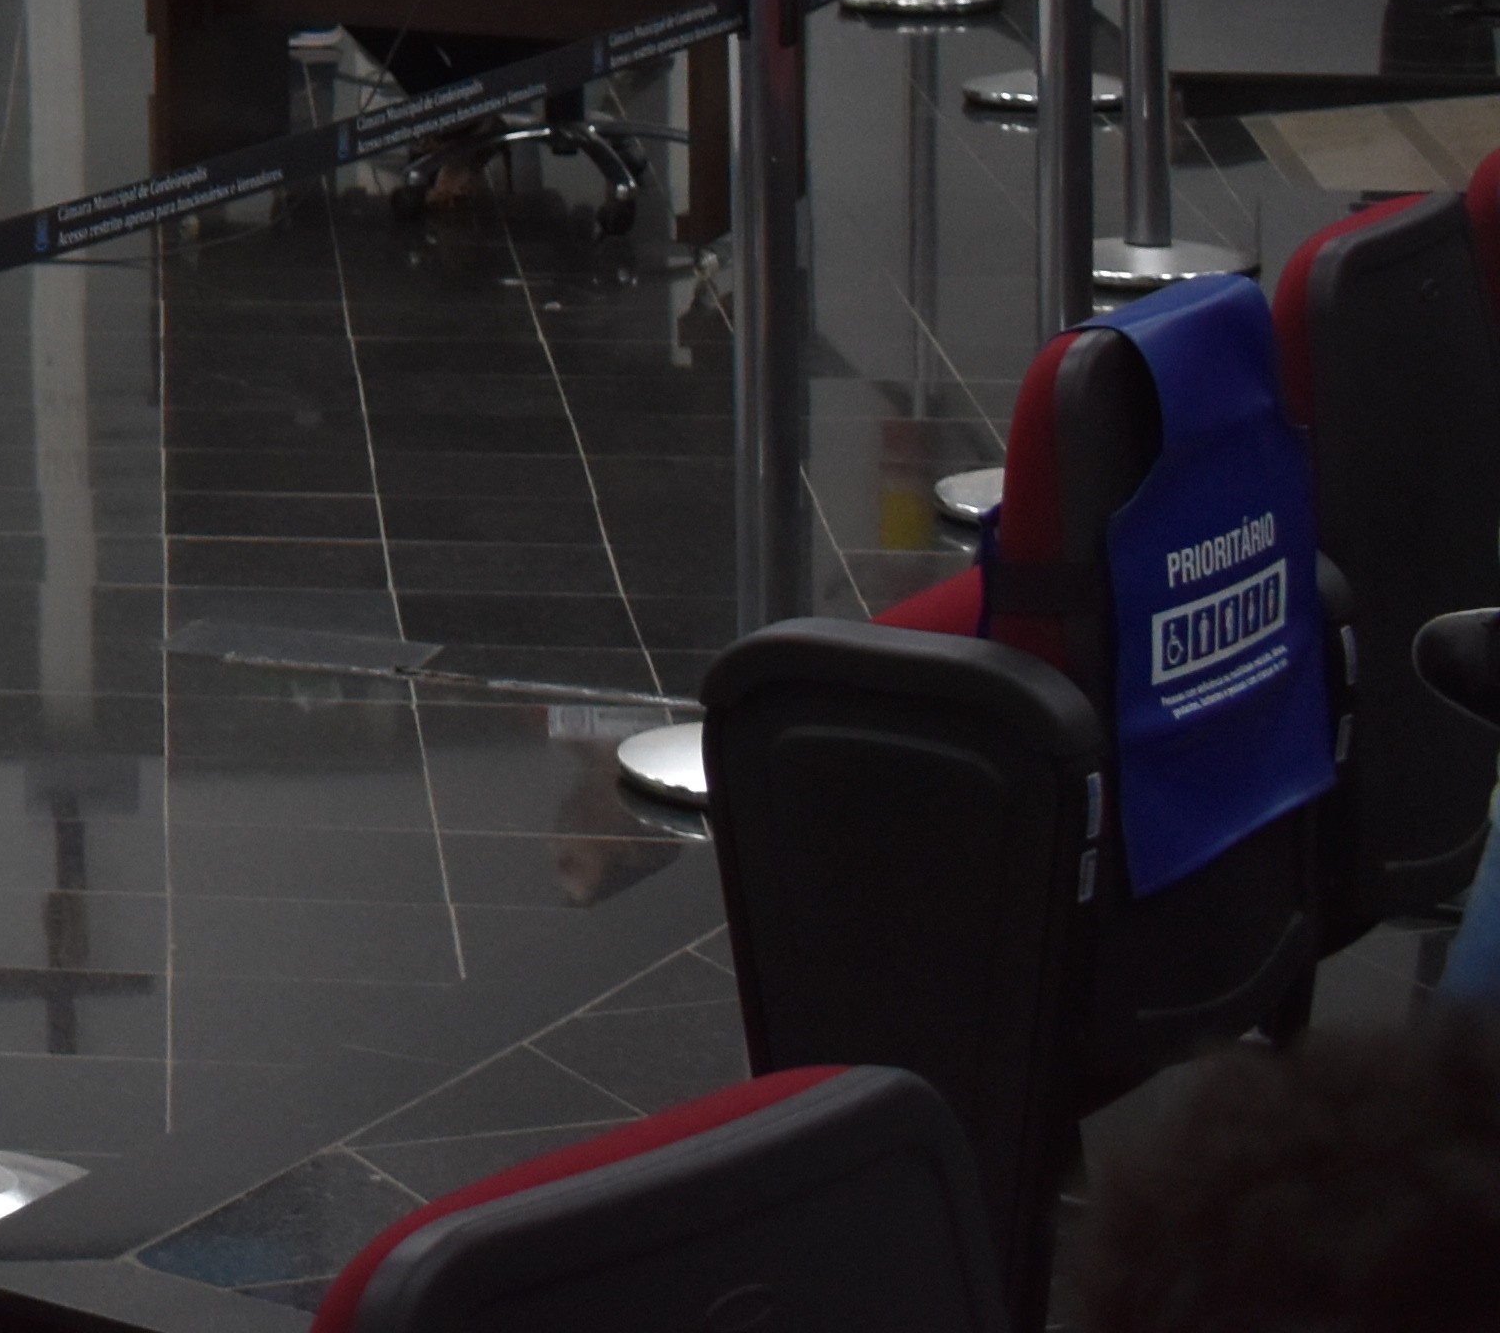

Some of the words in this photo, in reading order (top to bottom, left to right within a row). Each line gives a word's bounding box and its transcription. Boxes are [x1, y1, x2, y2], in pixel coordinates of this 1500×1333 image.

[57, 200, 93, 222] Câmara
[92, 186, 138, 210] Municipal
[137, 183, 149, 199] de
[58, 228, 89, 248] Acesso
[89, 216, 124, 238] restrito
[124, 208, 156, 230] apenas
[155, 201, 177, 221] para
[1166, 511, 1275, 589] PRIORITÁRIO
